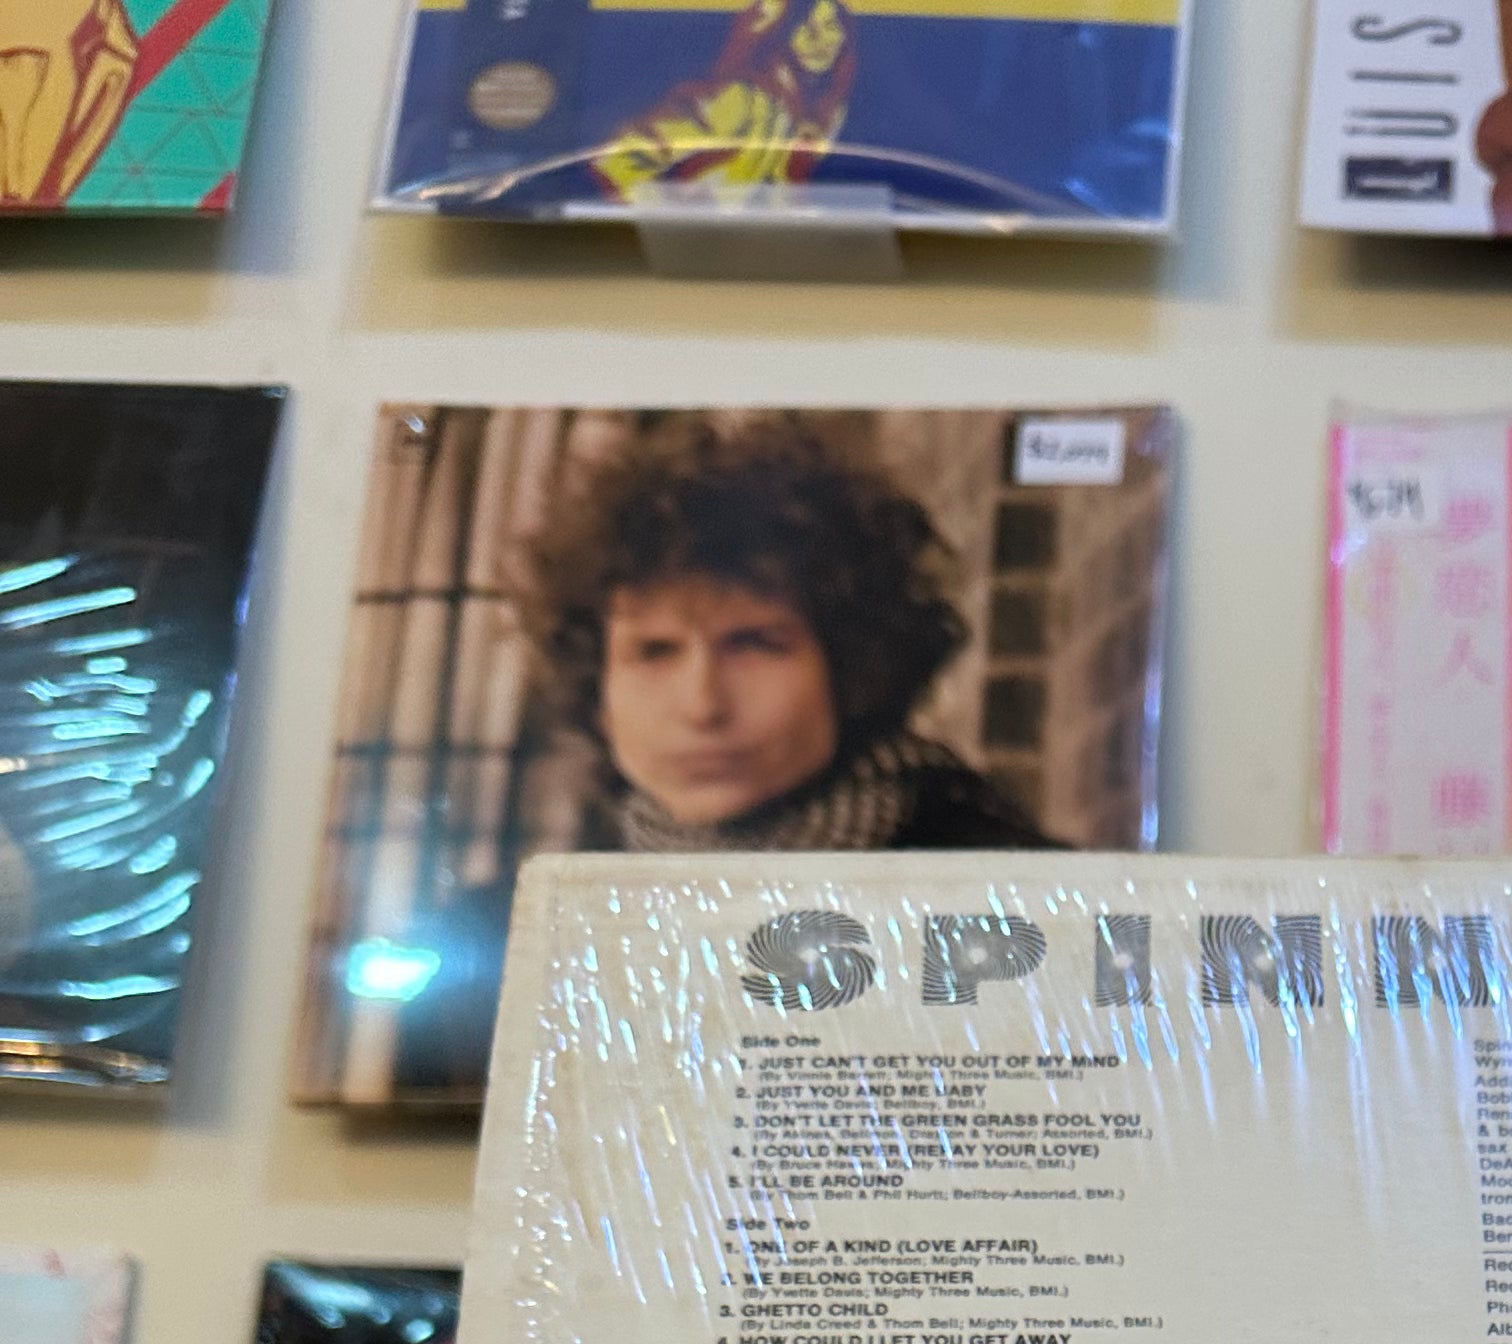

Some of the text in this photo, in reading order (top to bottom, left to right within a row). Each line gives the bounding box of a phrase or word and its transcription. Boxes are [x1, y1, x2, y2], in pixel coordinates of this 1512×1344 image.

[759, 1057, 804, 1069] JUST
[873, 1056, 909, 1069] GET
[917, 1056, 956, 1068] YOU
[962, 1056, 1002, 1068] OUT
[1006, 1056, 1032, 1068] OF
[1037, 1055, 1065, 1067] MY
[1071, 1055, 1120, 1068] MIND
[756, 1087, 803, 1099] JUST
[809, 1086, 850, 1098] YOU
[856, 1085, 896, 1097] AND
[902, 1085, 929, 1097] ME
[755, 1115, 812, 1128] DON'T
[819, 1115, 854, 1127] LET
[902, 1114, 967, 1127] GREEN
[973, 1114, 1039, 1126] GRASS
[1044, 1114, 1096, 1126] FOOL
[1102, 1113, 1141, 1126] YOU
[790, 1175, 814, 1187] BE
[821, 1175, 904, 1187] AROUND
[774, 1218, 810, 1230] Two
[793, 1240, 820, 1253] OF
[824, 1240, 838, 1252] A
[844, 1240, 891, 1252] KIND
[899, 1240, 956, 1255] (LOVE
[963, 1239, 1039, 1255] AFFAIR)
[780, 1272, 862, 1285] BELONG
[867, 1271, 974, 1284] TOGETHER
[720, 1303, 888, 1317] 3. GHETTO CHILD
